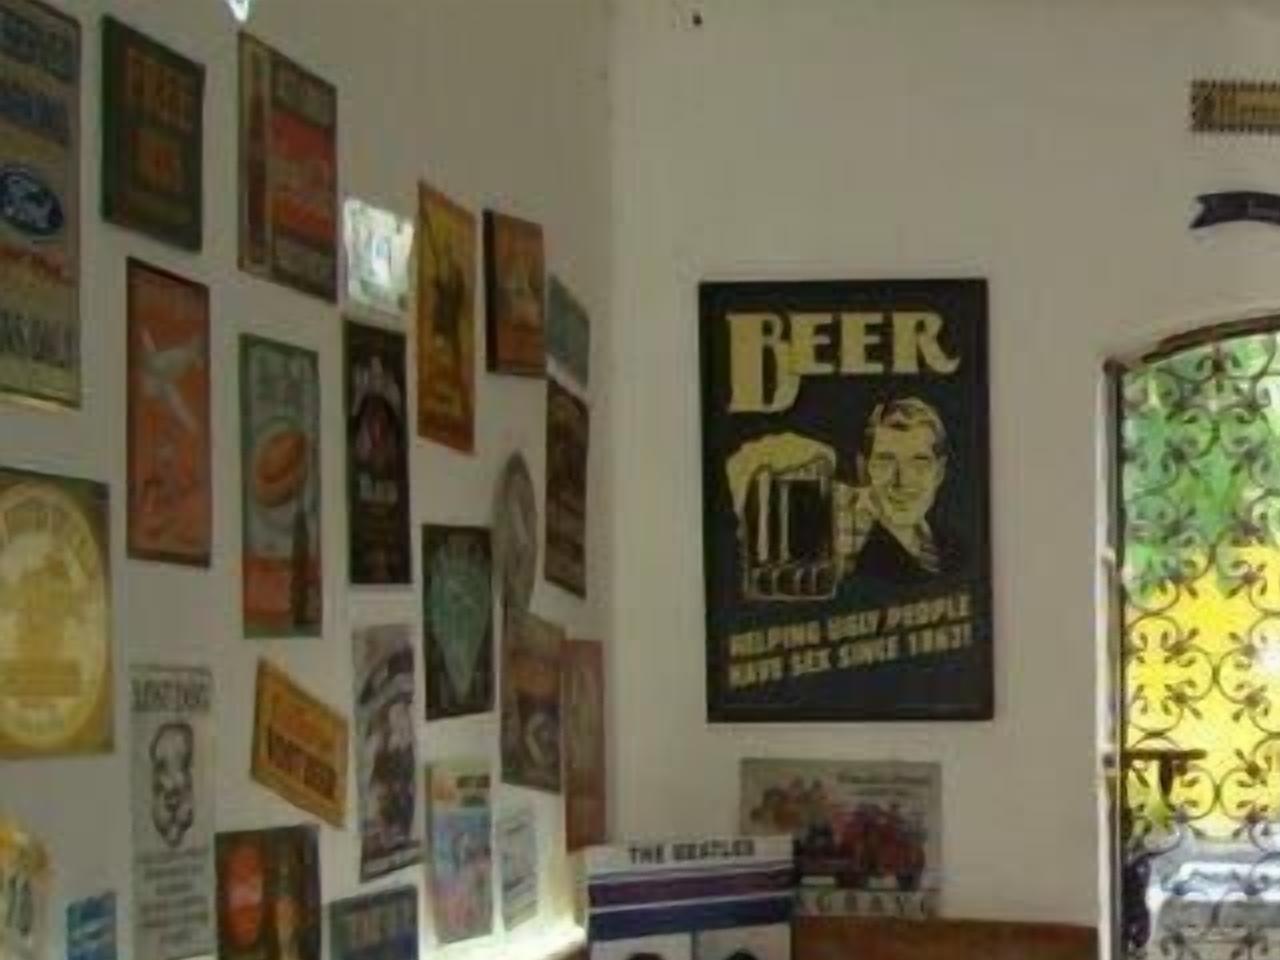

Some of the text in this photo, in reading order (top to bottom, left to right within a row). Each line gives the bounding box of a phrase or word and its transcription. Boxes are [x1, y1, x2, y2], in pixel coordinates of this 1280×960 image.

[725, 311, 961, 414] BEER
[729, 593, 972, 657] HELPING UGLY PEOPLE
[729, 656, 783, 690] HAVE
[791, 647, 830, 677] SEX
[838, 634, 899, 670] SINCE
[629, 839, 755, 865] THE BEATLES
